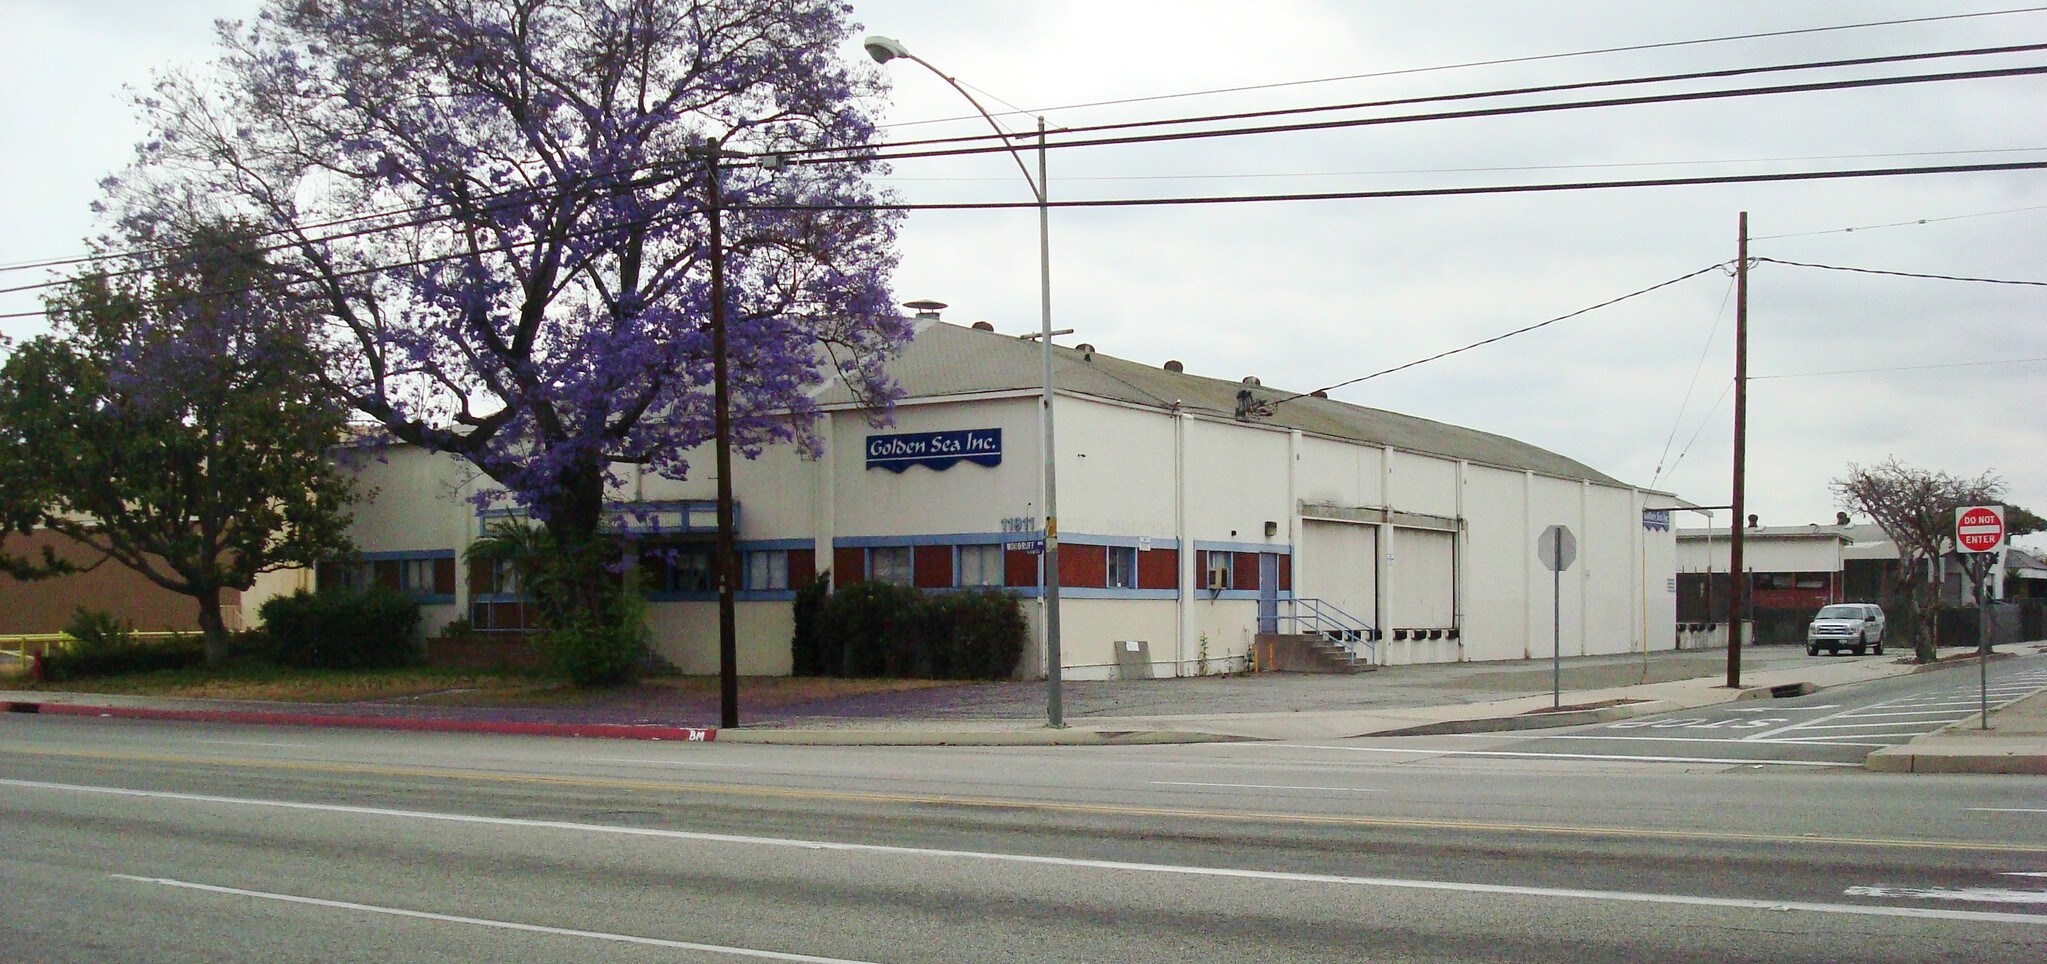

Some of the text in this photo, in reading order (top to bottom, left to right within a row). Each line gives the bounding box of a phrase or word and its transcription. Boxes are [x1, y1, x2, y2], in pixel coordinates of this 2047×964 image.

[870, 432, 996, 456] Golden Sea Inc.
[1001, 517, 1034, 531] 11911
[1964, 515, 1995, 524] DO NOT
[1965, 535, 1995, 544] ENTER
[1606, 718, 1789, 729] STOP
